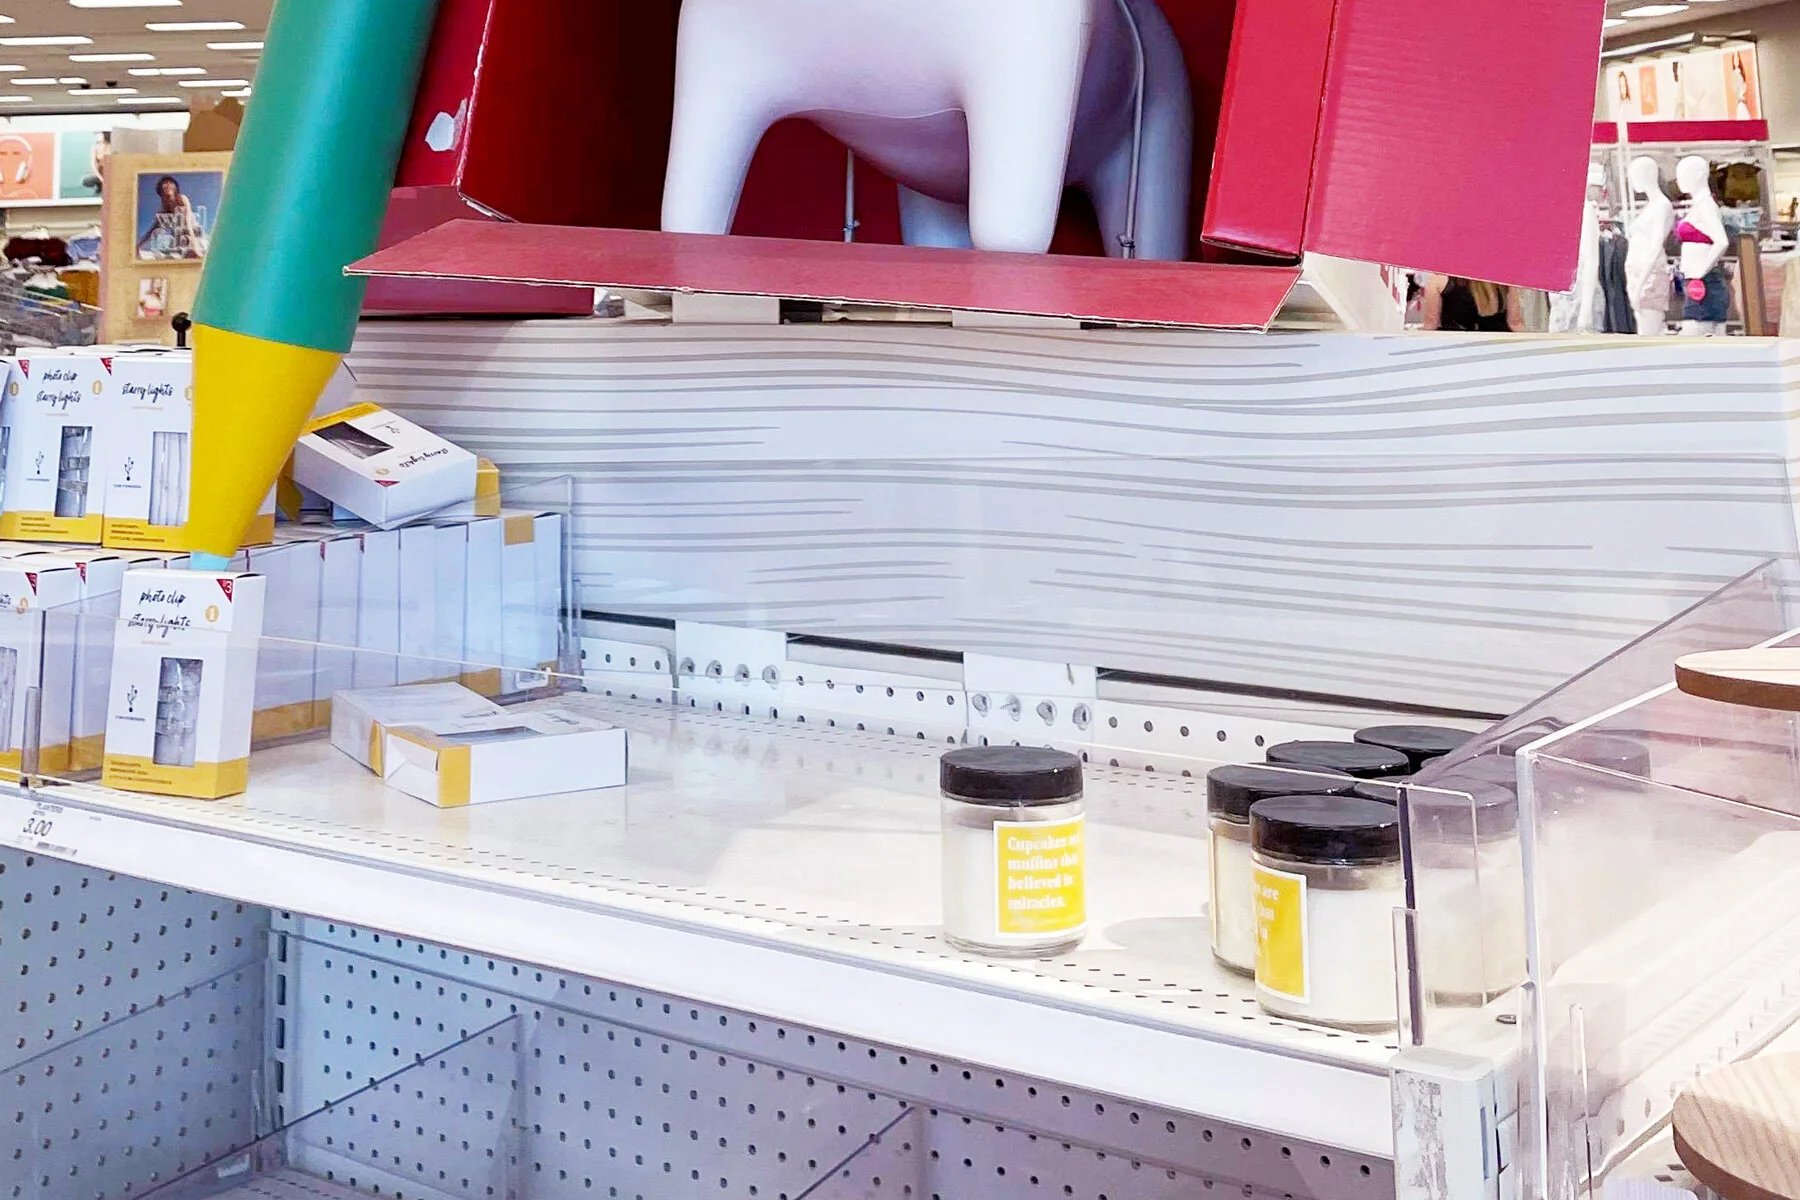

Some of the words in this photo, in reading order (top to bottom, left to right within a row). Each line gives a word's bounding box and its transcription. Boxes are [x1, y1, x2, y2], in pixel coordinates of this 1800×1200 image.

[58, 390, 82, 410] lights
[147, 381, 174, 403] lights
[139, 588, 165, 604] photo
[166, 590, 187, 606] clip
[23, 817, 52, 836] 3.00
[1007, 835, 1066, 855] Cupcakes
[1007, 855, 1058, 870] muffins
[1007, 874, 1061, 890] believed
